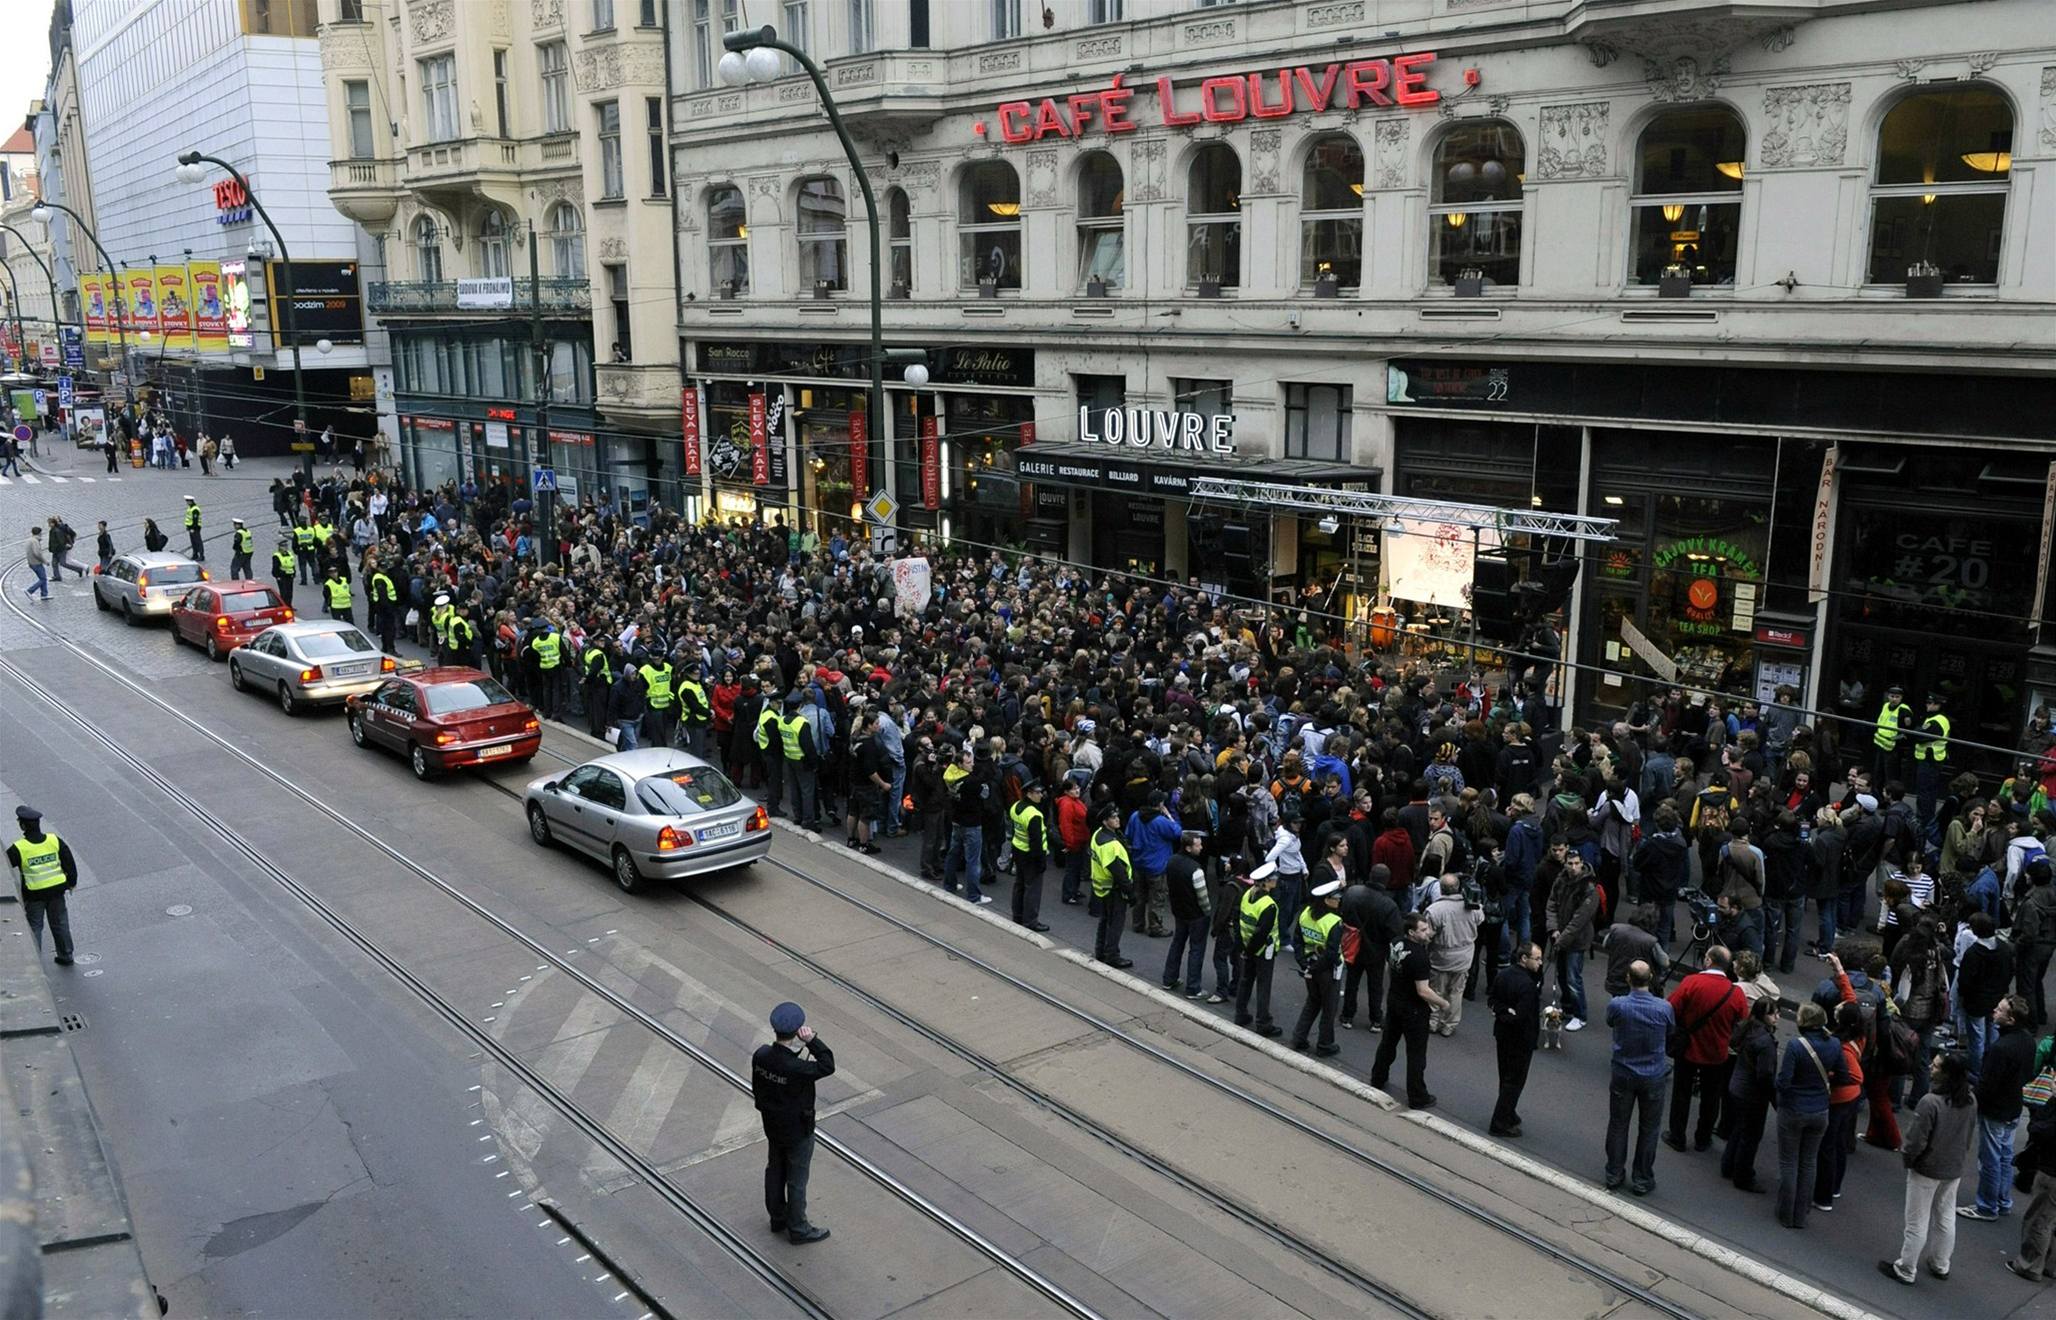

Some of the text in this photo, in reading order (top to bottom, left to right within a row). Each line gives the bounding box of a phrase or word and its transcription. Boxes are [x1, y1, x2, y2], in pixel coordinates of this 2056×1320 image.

[998, 52, 1440, 144] CAFÉ LOUVRE
[213, 178, 247, 209] TESCO
[199, 320, 225, 329] STOVKY
[685, 392, 699, 470] SLEVA ZLATA
[752, 398, 764, 437] SLEVA
[1080, 405, 1234, 454] LOUVRE
[1020, 461, 1188, 488] GALERIE RESTAURACE BILLIARD KAVÁRNA
[1821, 458, 1834, 488] BAR
[1814, 501, 1829, 571] NARODNI
[1895, 533, 1992, 557] CAFE
[1691, 562, 1718, 577] TEA
[1894, 555, 1988, 589] #20
[1679, 621, 1721, 636] TEA SHOP
